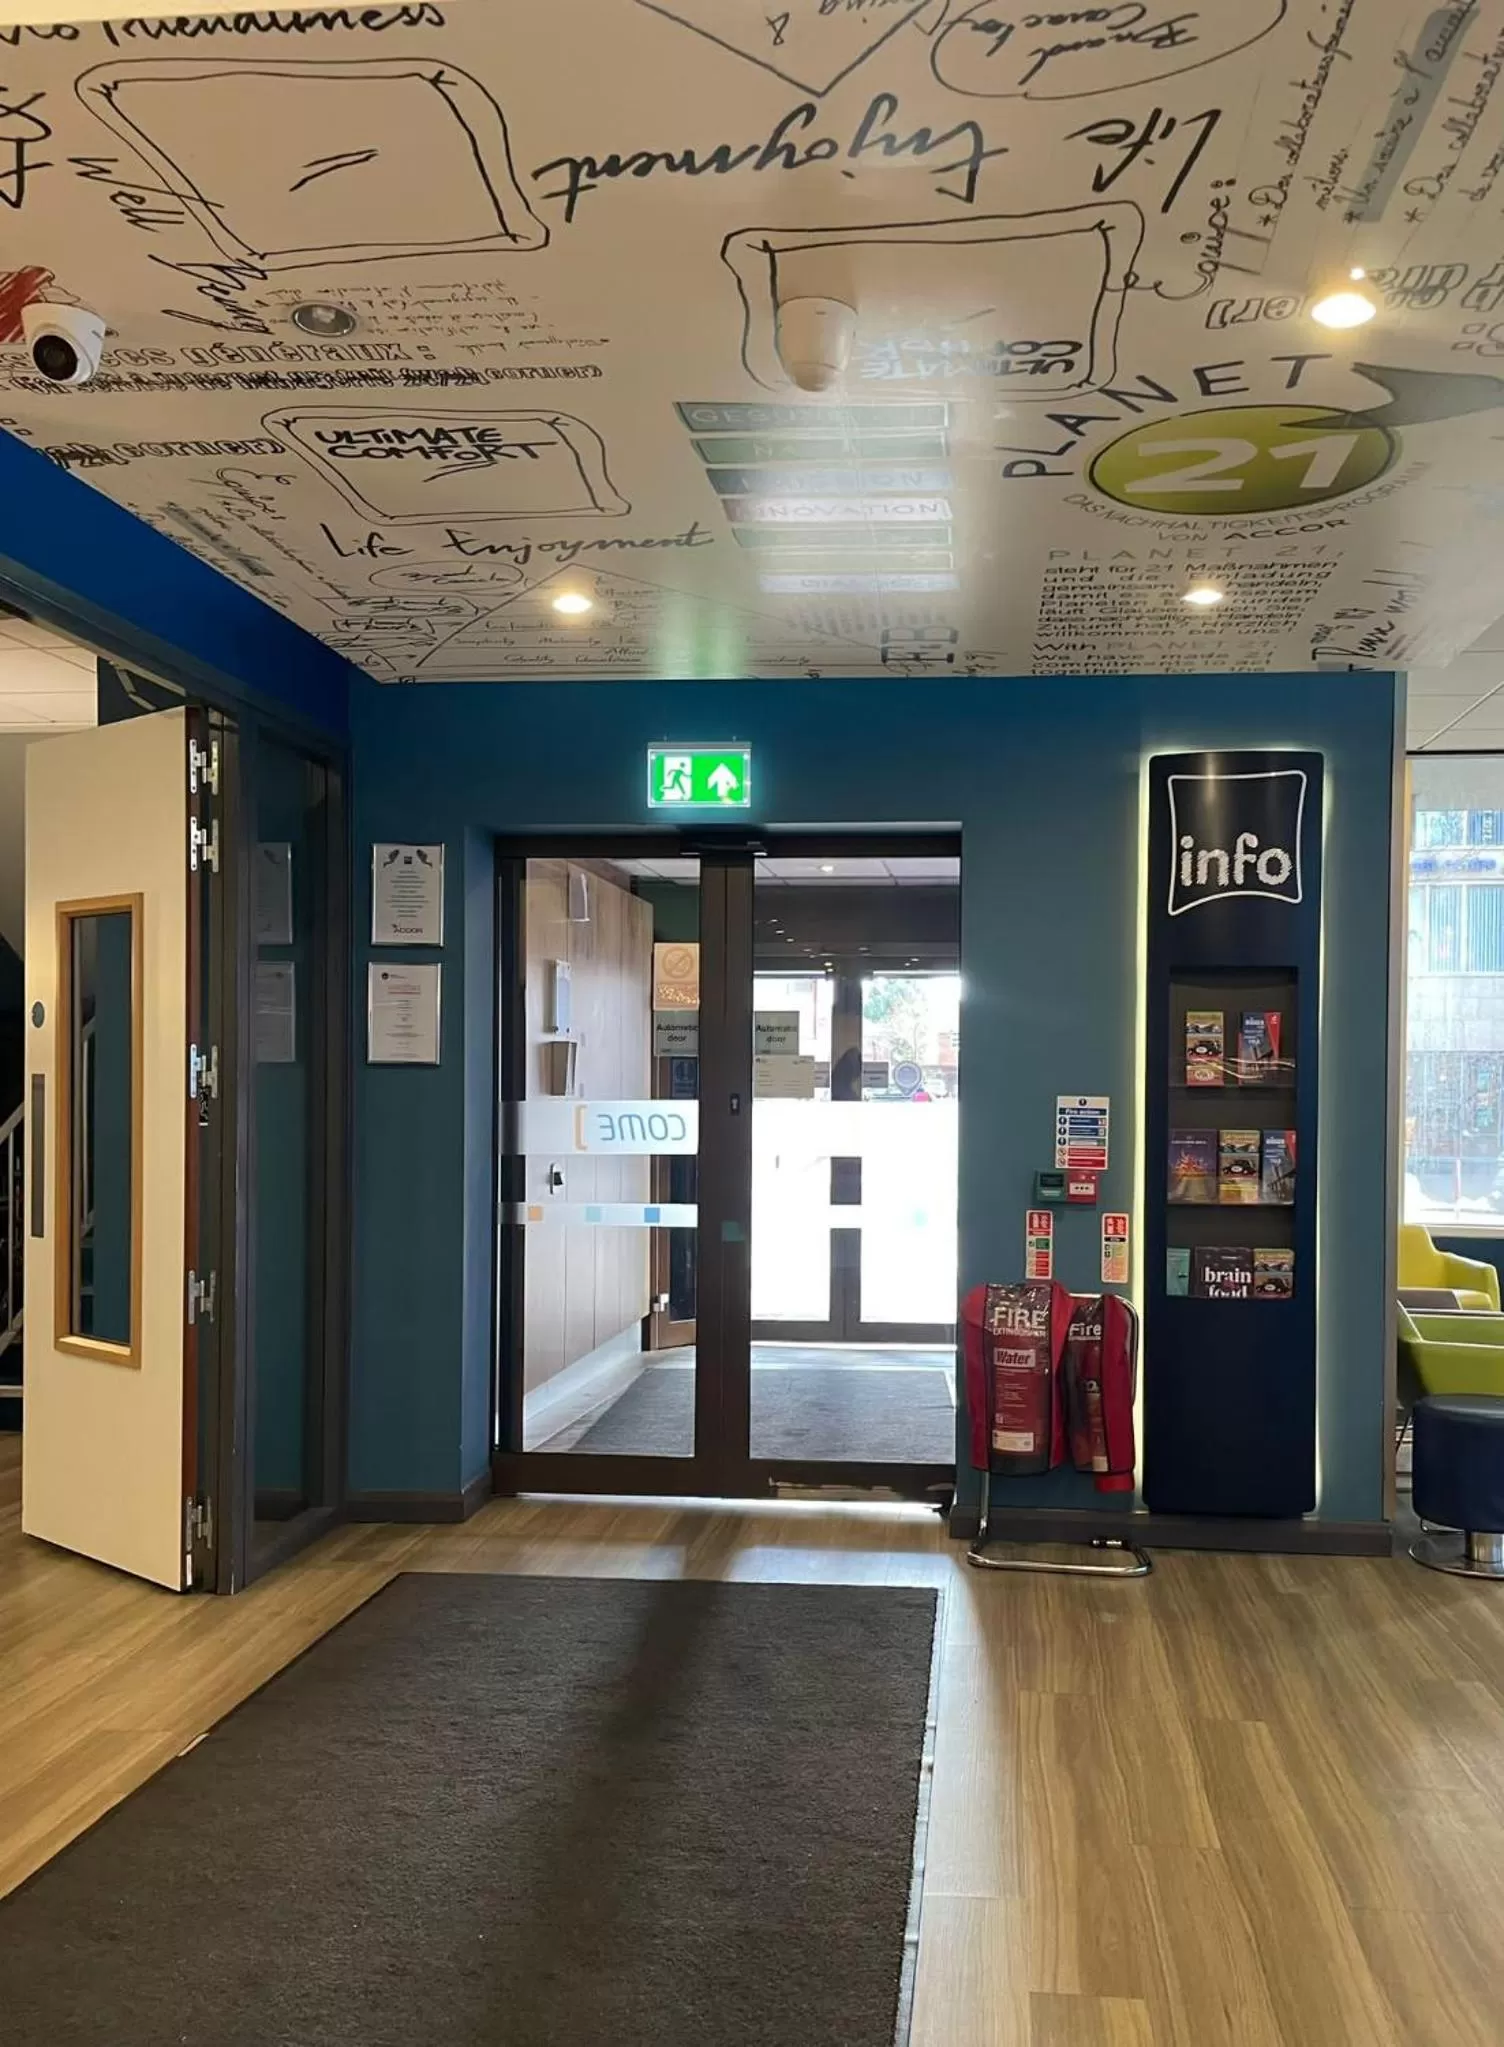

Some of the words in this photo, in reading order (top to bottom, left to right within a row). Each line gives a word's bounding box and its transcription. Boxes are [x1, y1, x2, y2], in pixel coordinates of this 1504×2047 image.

[532, 93, 1007, 224] Enjoyment
[1062, 108, 1222, 214] Life
[1002, 353, 1333, 479] PLANET
[314, 426, 505, 446] ULTIMATE
[1124, 433, 1362, 494] 21
[1223, 518, 1351, 541] ACCOR
[320, 521, 413, 558] Life
[440, 521, 715, 565] Enjoyment
[1048, 546, 1243, 560] PLANET
[1044, 565, 1100, 575] steht
[1108, 564, 1137, 574] für
[1144, 564, 1175, 573] 21
[1185, 560, 1339, 572] Maßnahmen
[1043, 574, 1096, 583] und
[1119, 573, 1160, 582] die
[1033, 642, 1098, 652] With
[1179, 832, 1292, 886] info
[666, 1033, 687, 1043] door
[1204, 1266, 1252, 1283] brain
[1208, 1284, 1248, 1298] food
[993, 1306, 1046, 1330] FIRE
[1069, 1323, 1101, 1336] Fire
[996, 1350, 1031, 1364] Water
